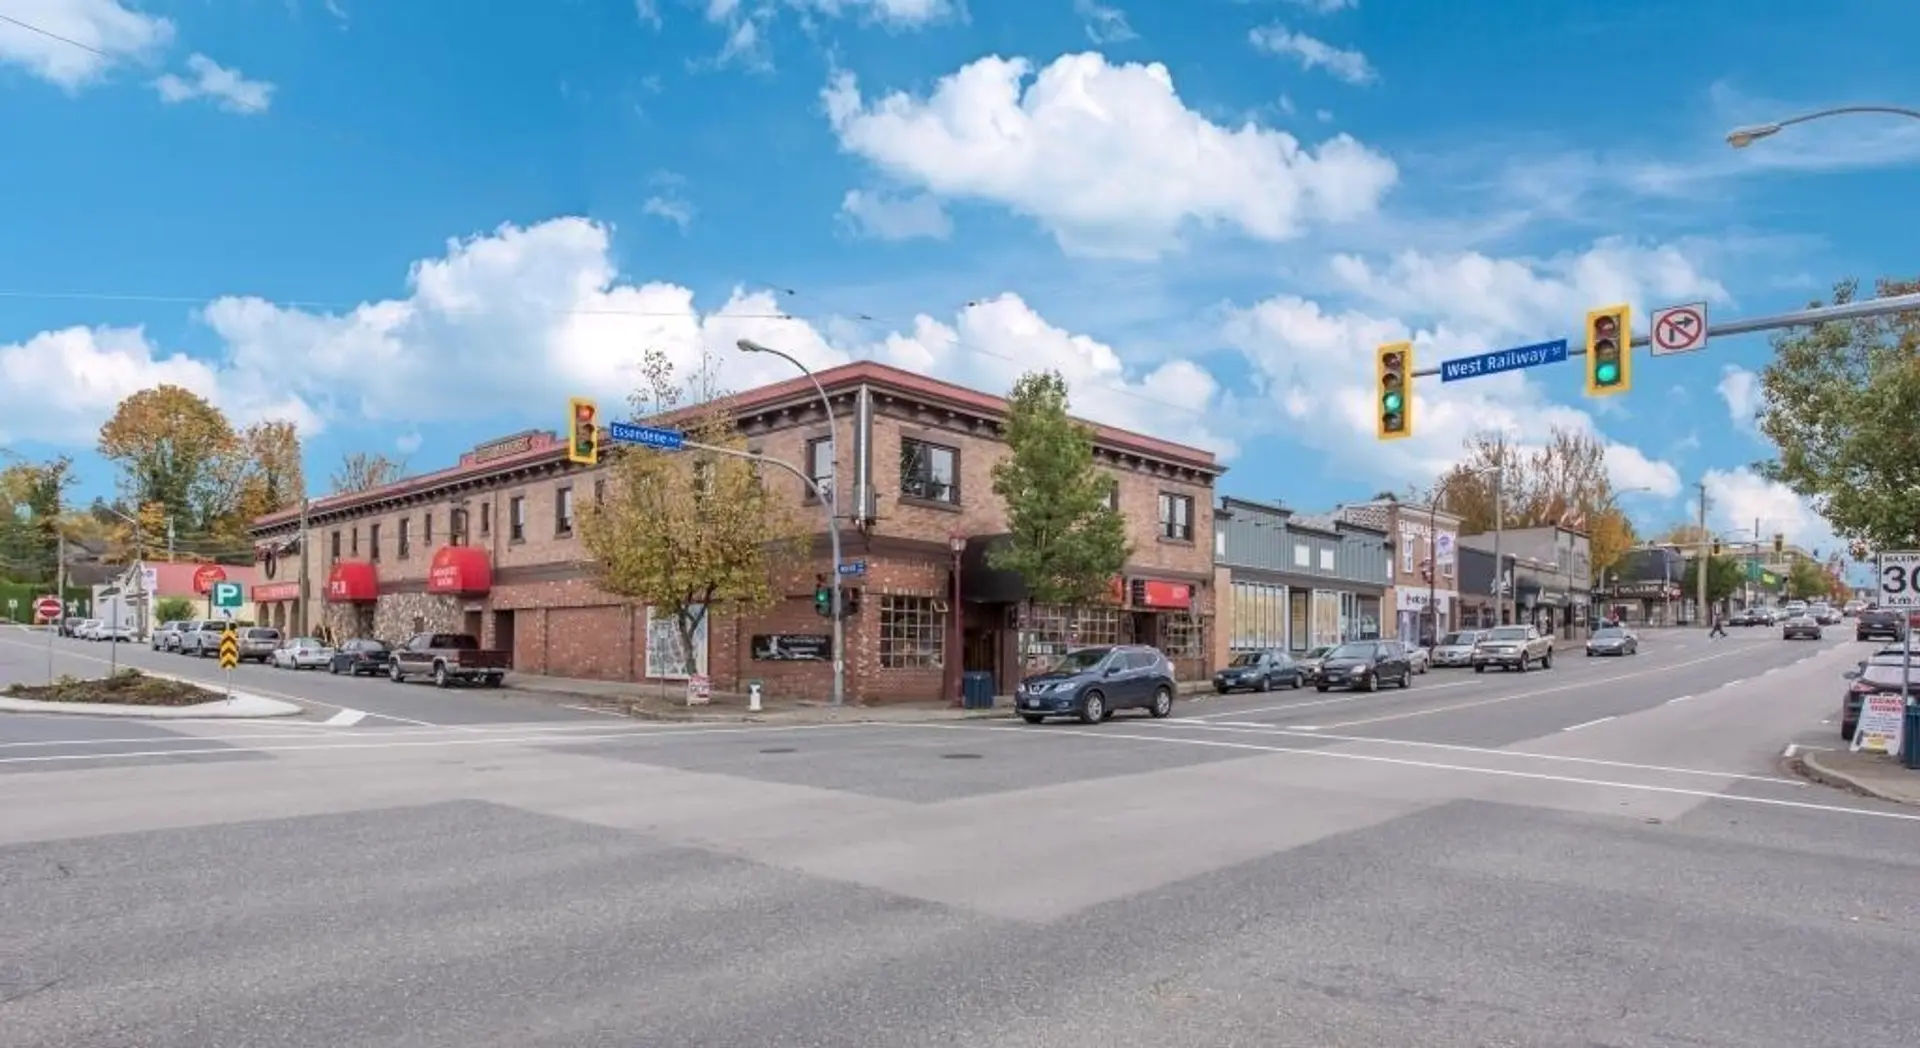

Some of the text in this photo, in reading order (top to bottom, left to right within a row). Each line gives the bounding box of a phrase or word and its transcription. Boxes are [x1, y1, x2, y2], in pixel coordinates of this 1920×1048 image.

[1447, 359, 1481, 377] West
[1487, 348, 1548, 371] Railway
[217, 584, 238, 605] P
